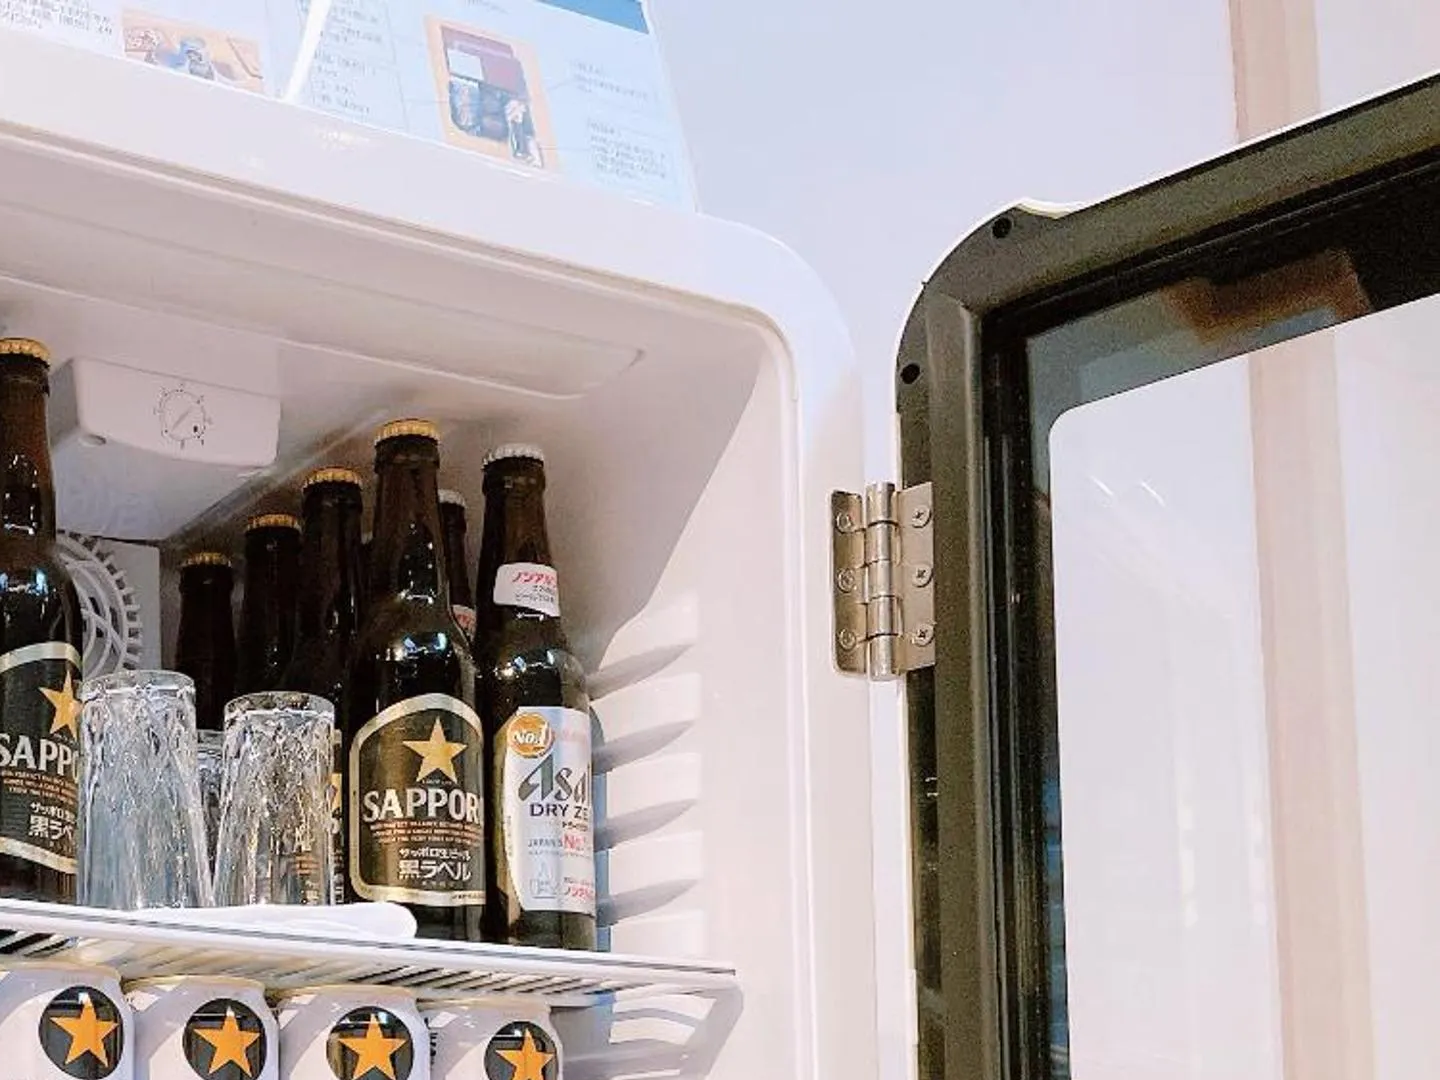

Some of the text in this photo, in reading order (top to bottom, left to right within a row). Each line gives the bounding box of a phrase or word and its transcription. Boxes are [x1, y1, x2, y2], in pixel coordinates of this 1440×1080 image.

[363, 788, 483, 825] SAPPOR
[530, 803, 569, 817] DRY
[399, 860, 472, 881] 黒ラベル
